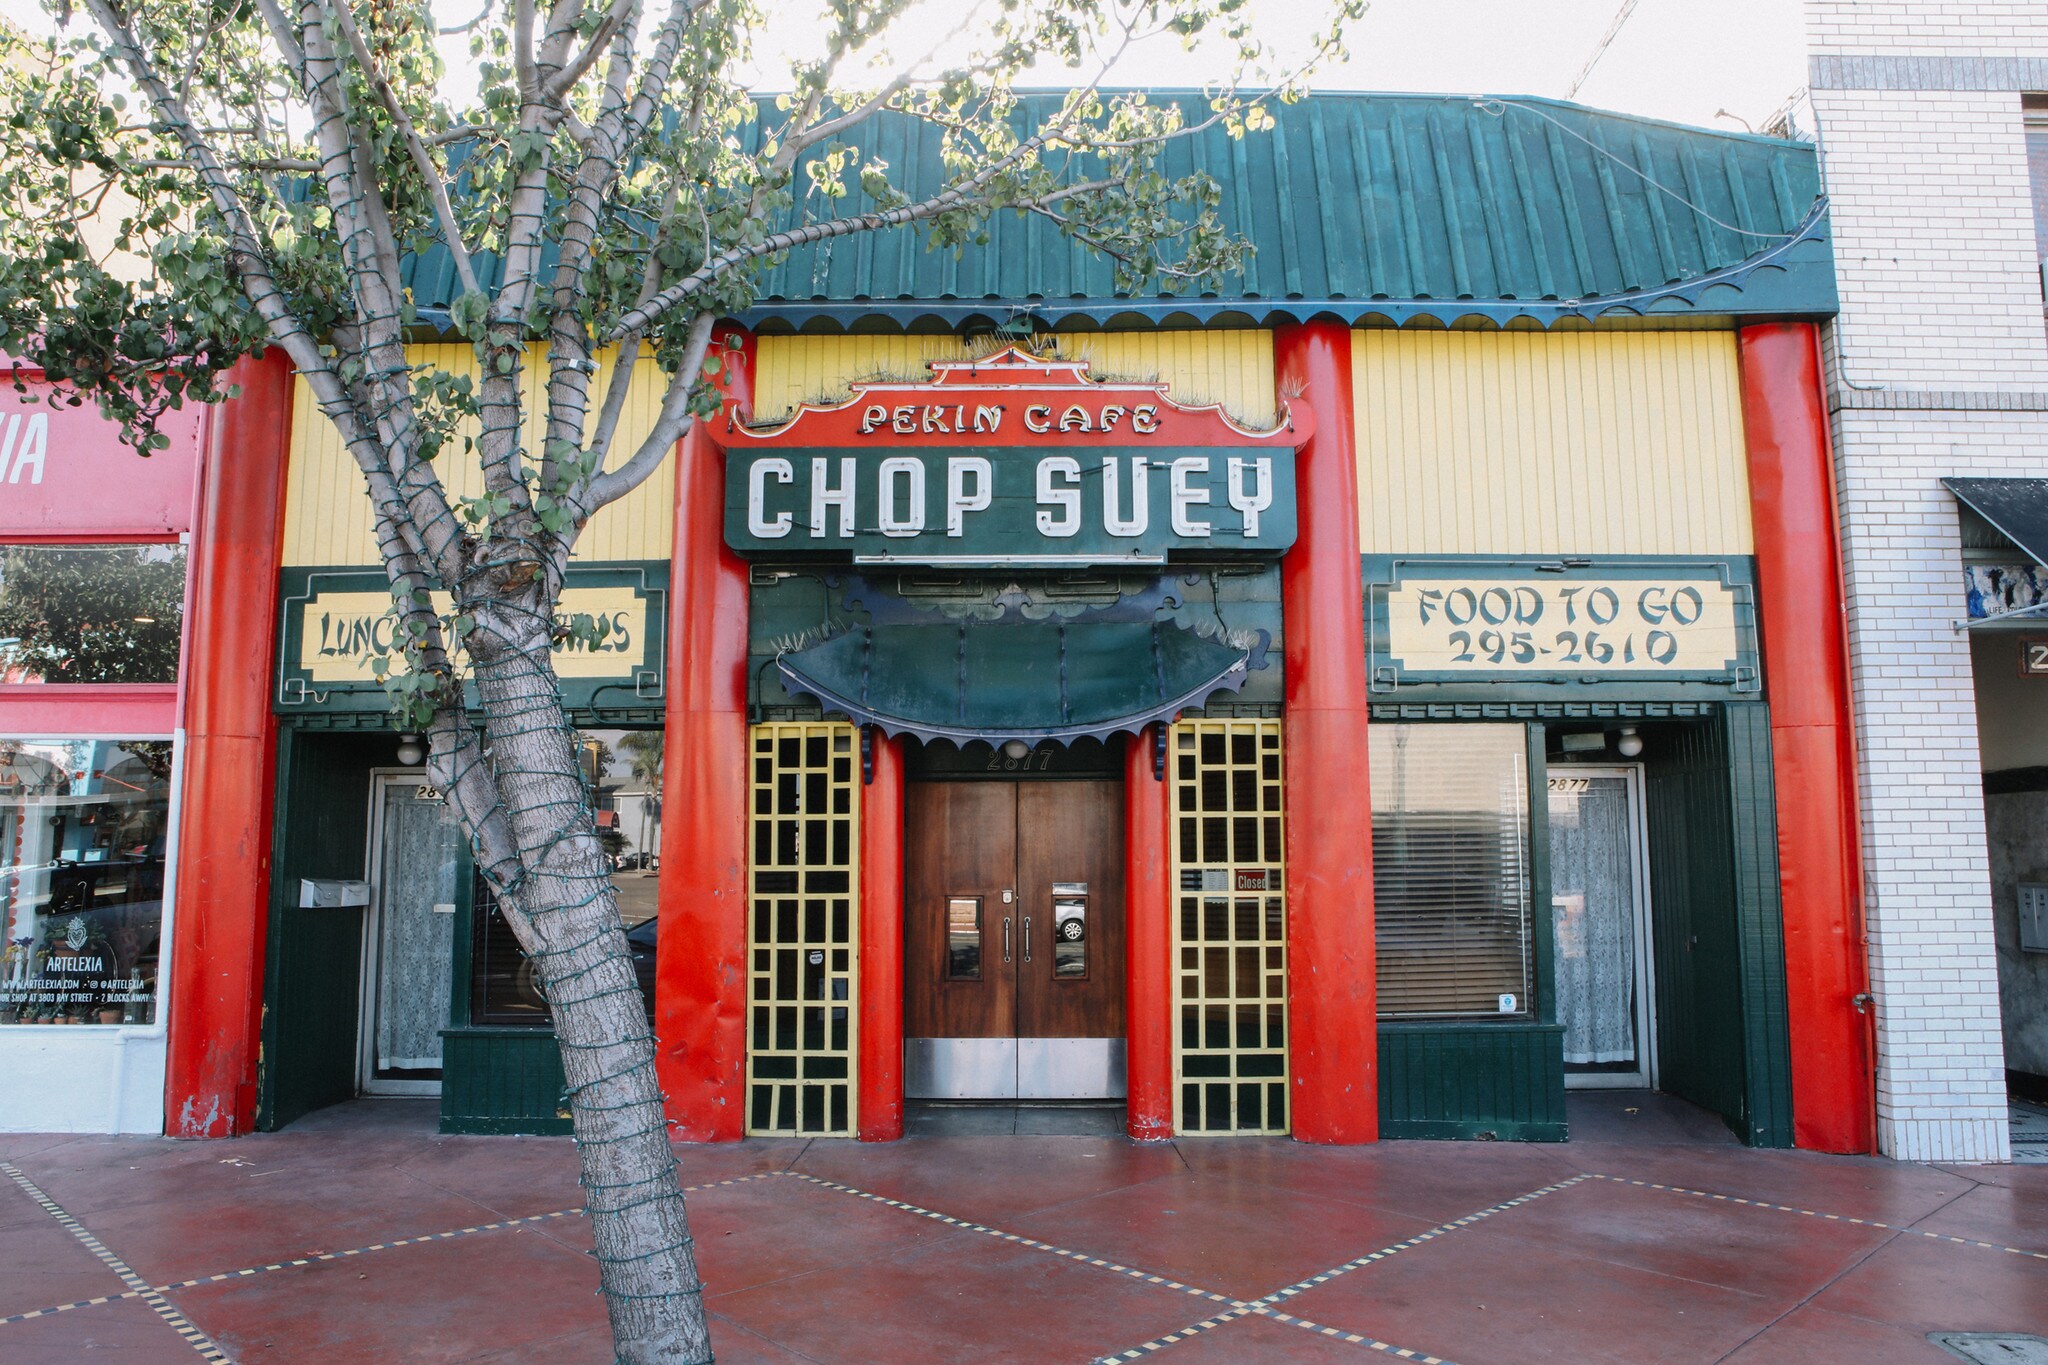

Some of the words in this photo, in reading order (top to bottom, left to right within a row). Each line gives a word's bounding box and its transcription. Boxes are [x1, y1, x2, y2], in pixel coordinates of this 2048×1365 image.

[863, 404, 1002, 434] PEKIN
[1023, 404, 1159, 434] CAFE
[0, 411, 48, 484] IA
[748, 457, 993, 538] CHOP
[1036, 456, 1273, 538] SUEY
[1416, 586, 1545, 626] FOOD
[1558, 586, 1620, 626] TO
[1637, 586, 1704, 626] GO
[1449, 630, 1678, 665] 295-2610
[1548, 778, 1589, 791] 2877
[46, 956, 103, 972] ARTELEXIA
[2, 979, 80, 989] WWW.ARTELEXIA.COM
[100, 979, 145, 989] @ARTELEXIA
[11, 993, 28, 1003] SHOP
[29, 993, 37, 1002] AT
[56, 993, 69, 1003] RAY
[70, 993, 94, 1003] STREET
[101, 993, 106, 1003] 2
[107, 993, 130, 1003] BLOCKS
[131, 993, 150, 1003] AWAY
